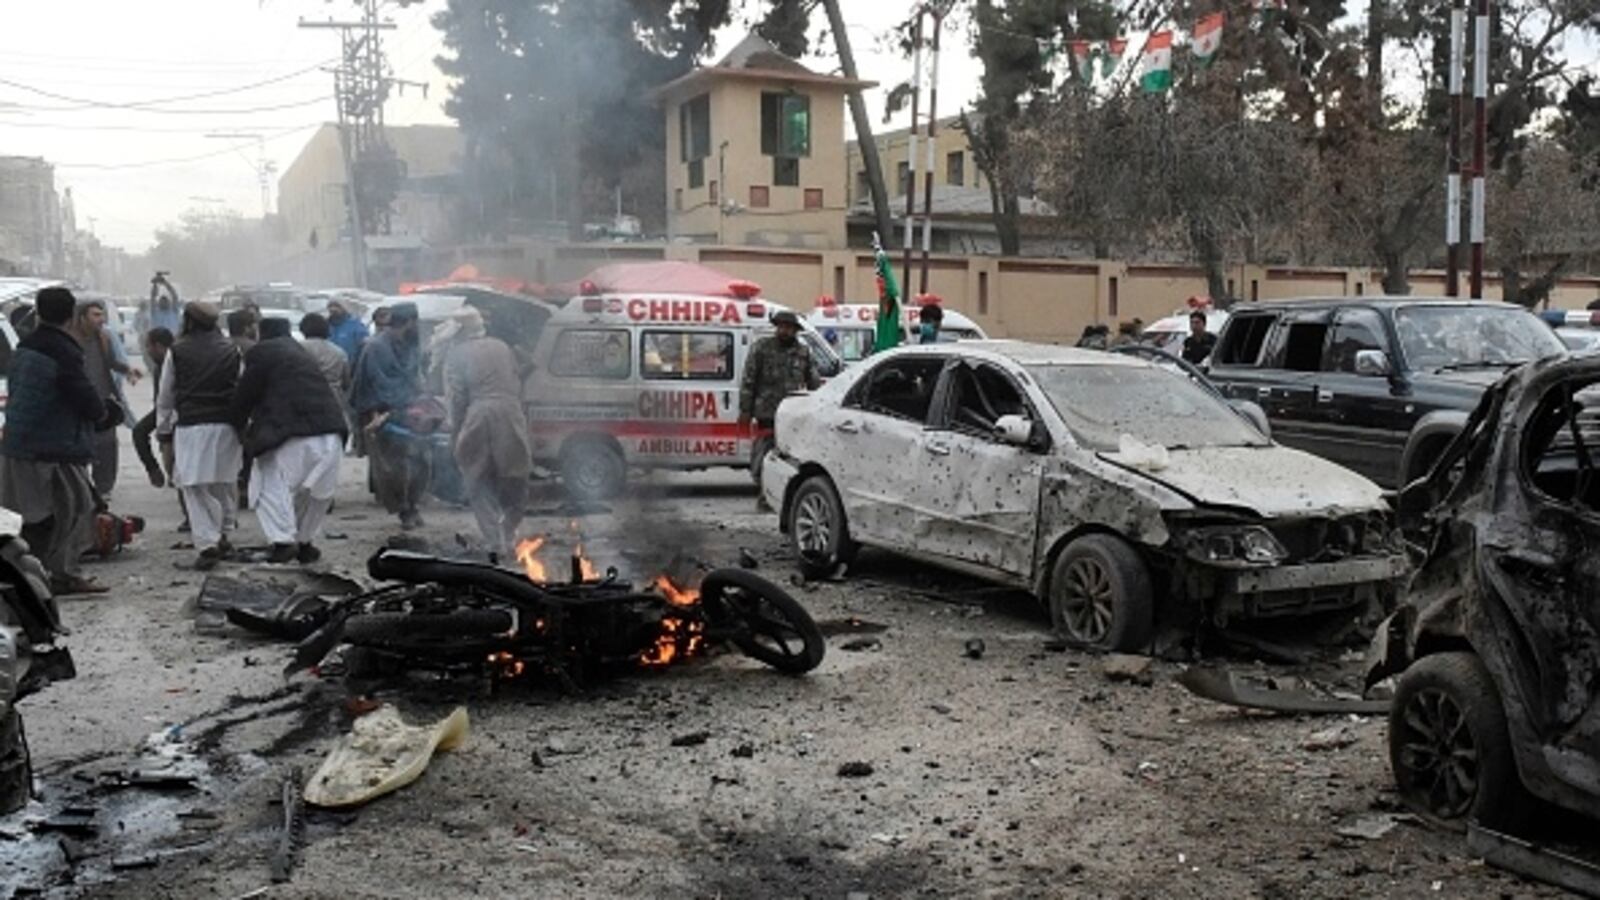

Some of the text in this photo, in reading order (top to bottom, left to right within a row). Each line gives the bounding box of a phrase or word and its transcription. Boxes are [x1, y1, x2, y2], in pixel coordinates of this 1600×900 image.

[628, 299, 741, 323] CHHIPA
[638, 391, 718, 419] CHHIPA
[639, 439, 736, 456] AMBULANCE
